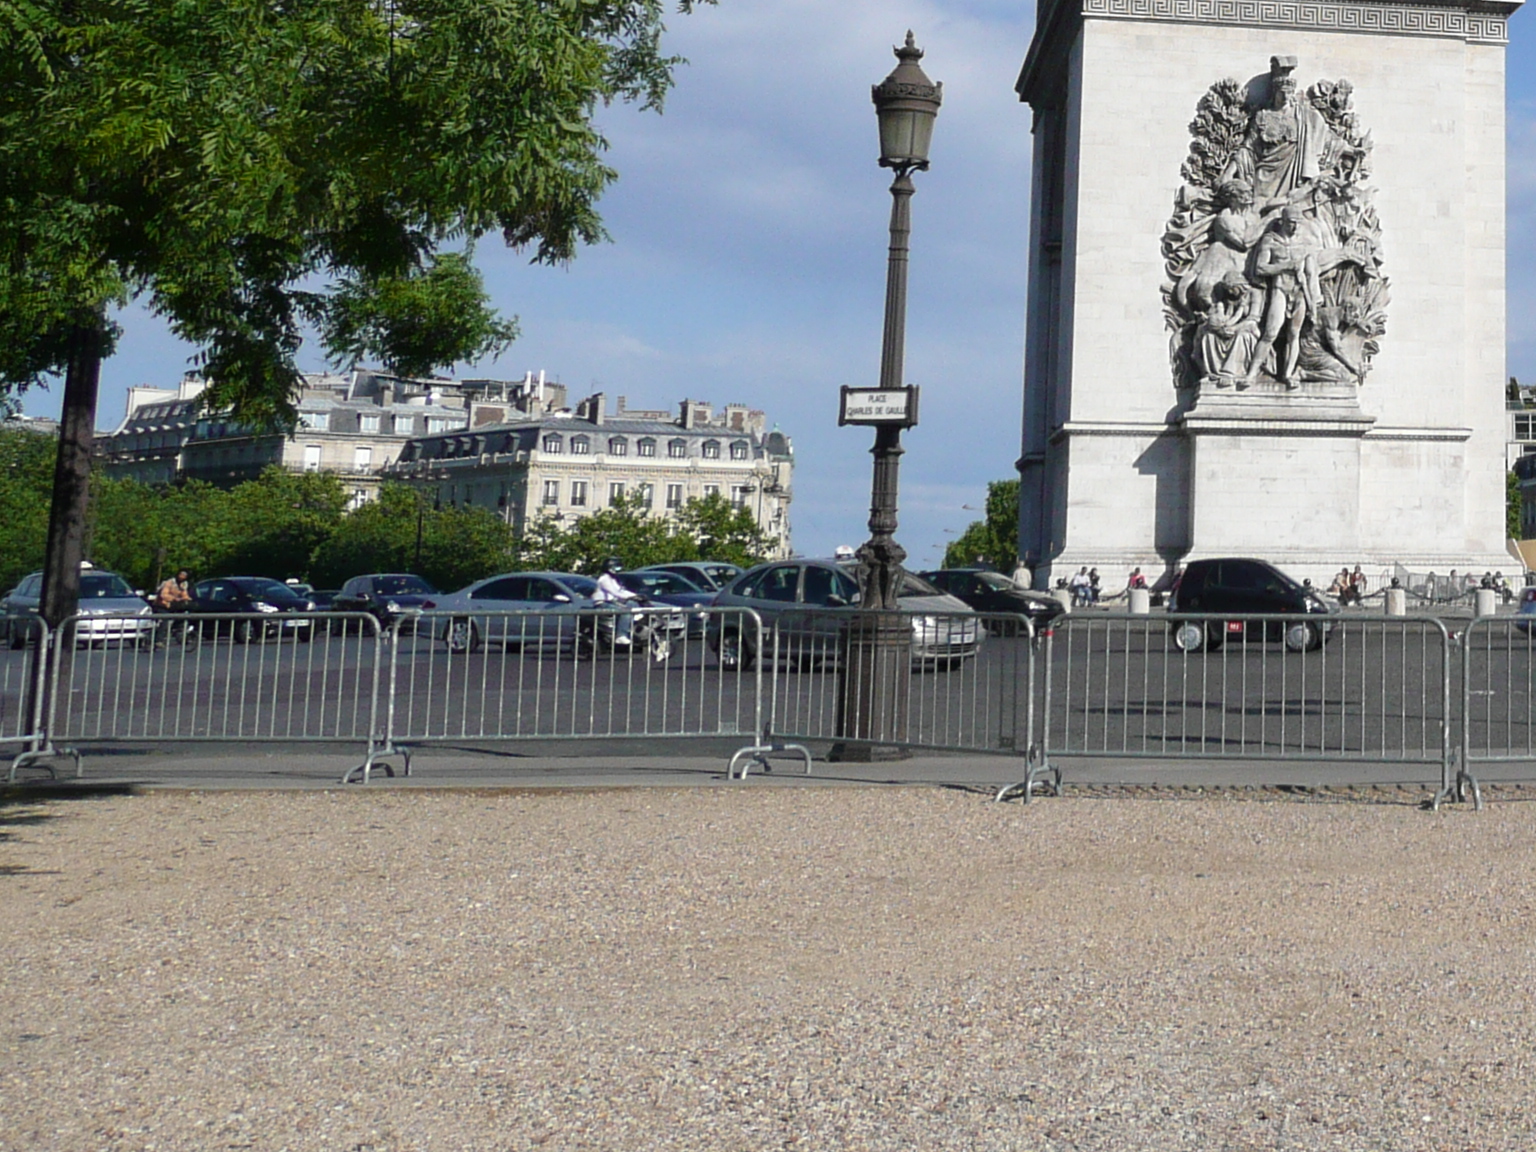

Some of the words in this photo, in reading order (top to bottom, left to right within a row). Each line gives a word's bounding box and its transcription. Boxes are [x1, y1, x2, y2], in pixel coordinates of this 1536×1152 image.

[868, 395, 887, 403] PLACE
[847, 406, 872, 415] CHARLES
[875, 406, 883, 415] DE
